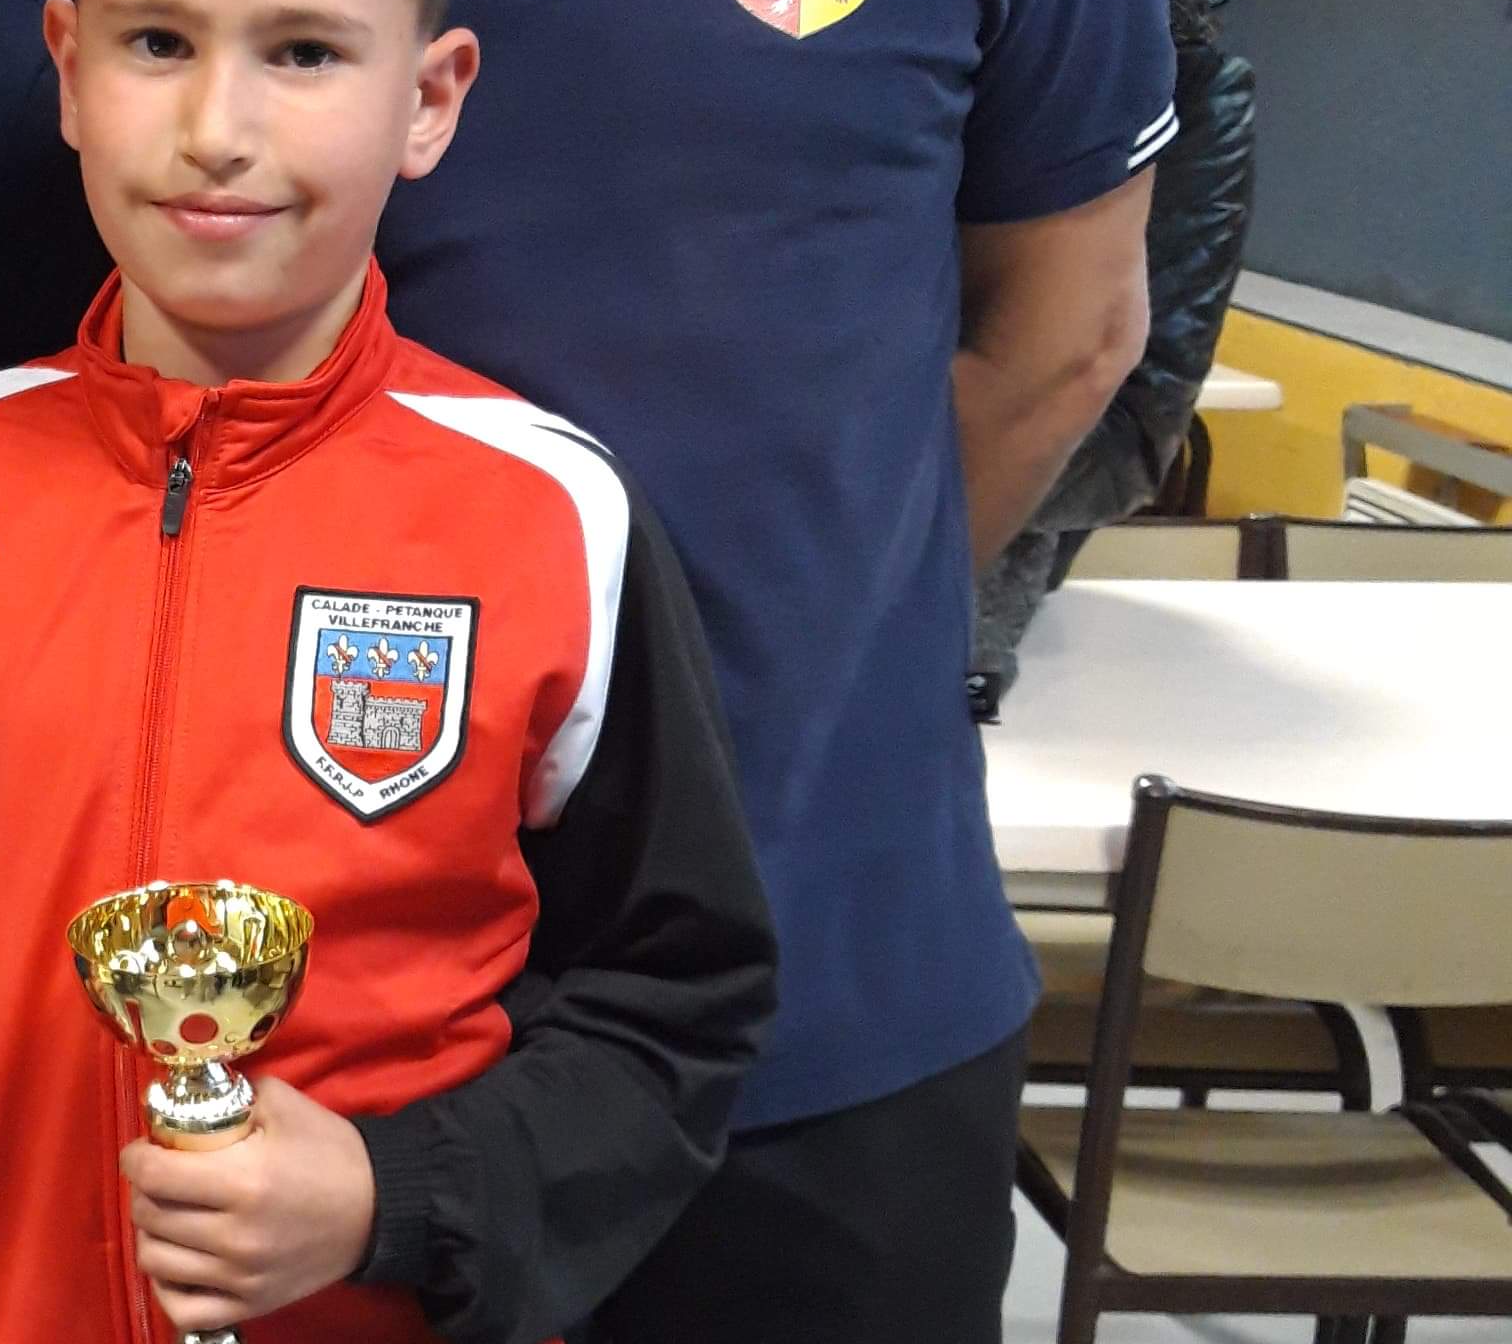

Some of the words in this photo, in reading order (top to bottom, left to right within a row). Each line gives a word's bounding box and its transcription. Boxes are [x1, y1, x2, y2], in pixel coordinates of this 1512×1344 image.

[311, 599, 370, 614] CALADE
[385, 604, 464, 619] PETANQUE
[328, 614, 444, 633] VILLEFRANCHE
[378, 765, 430, 800] RHONE
